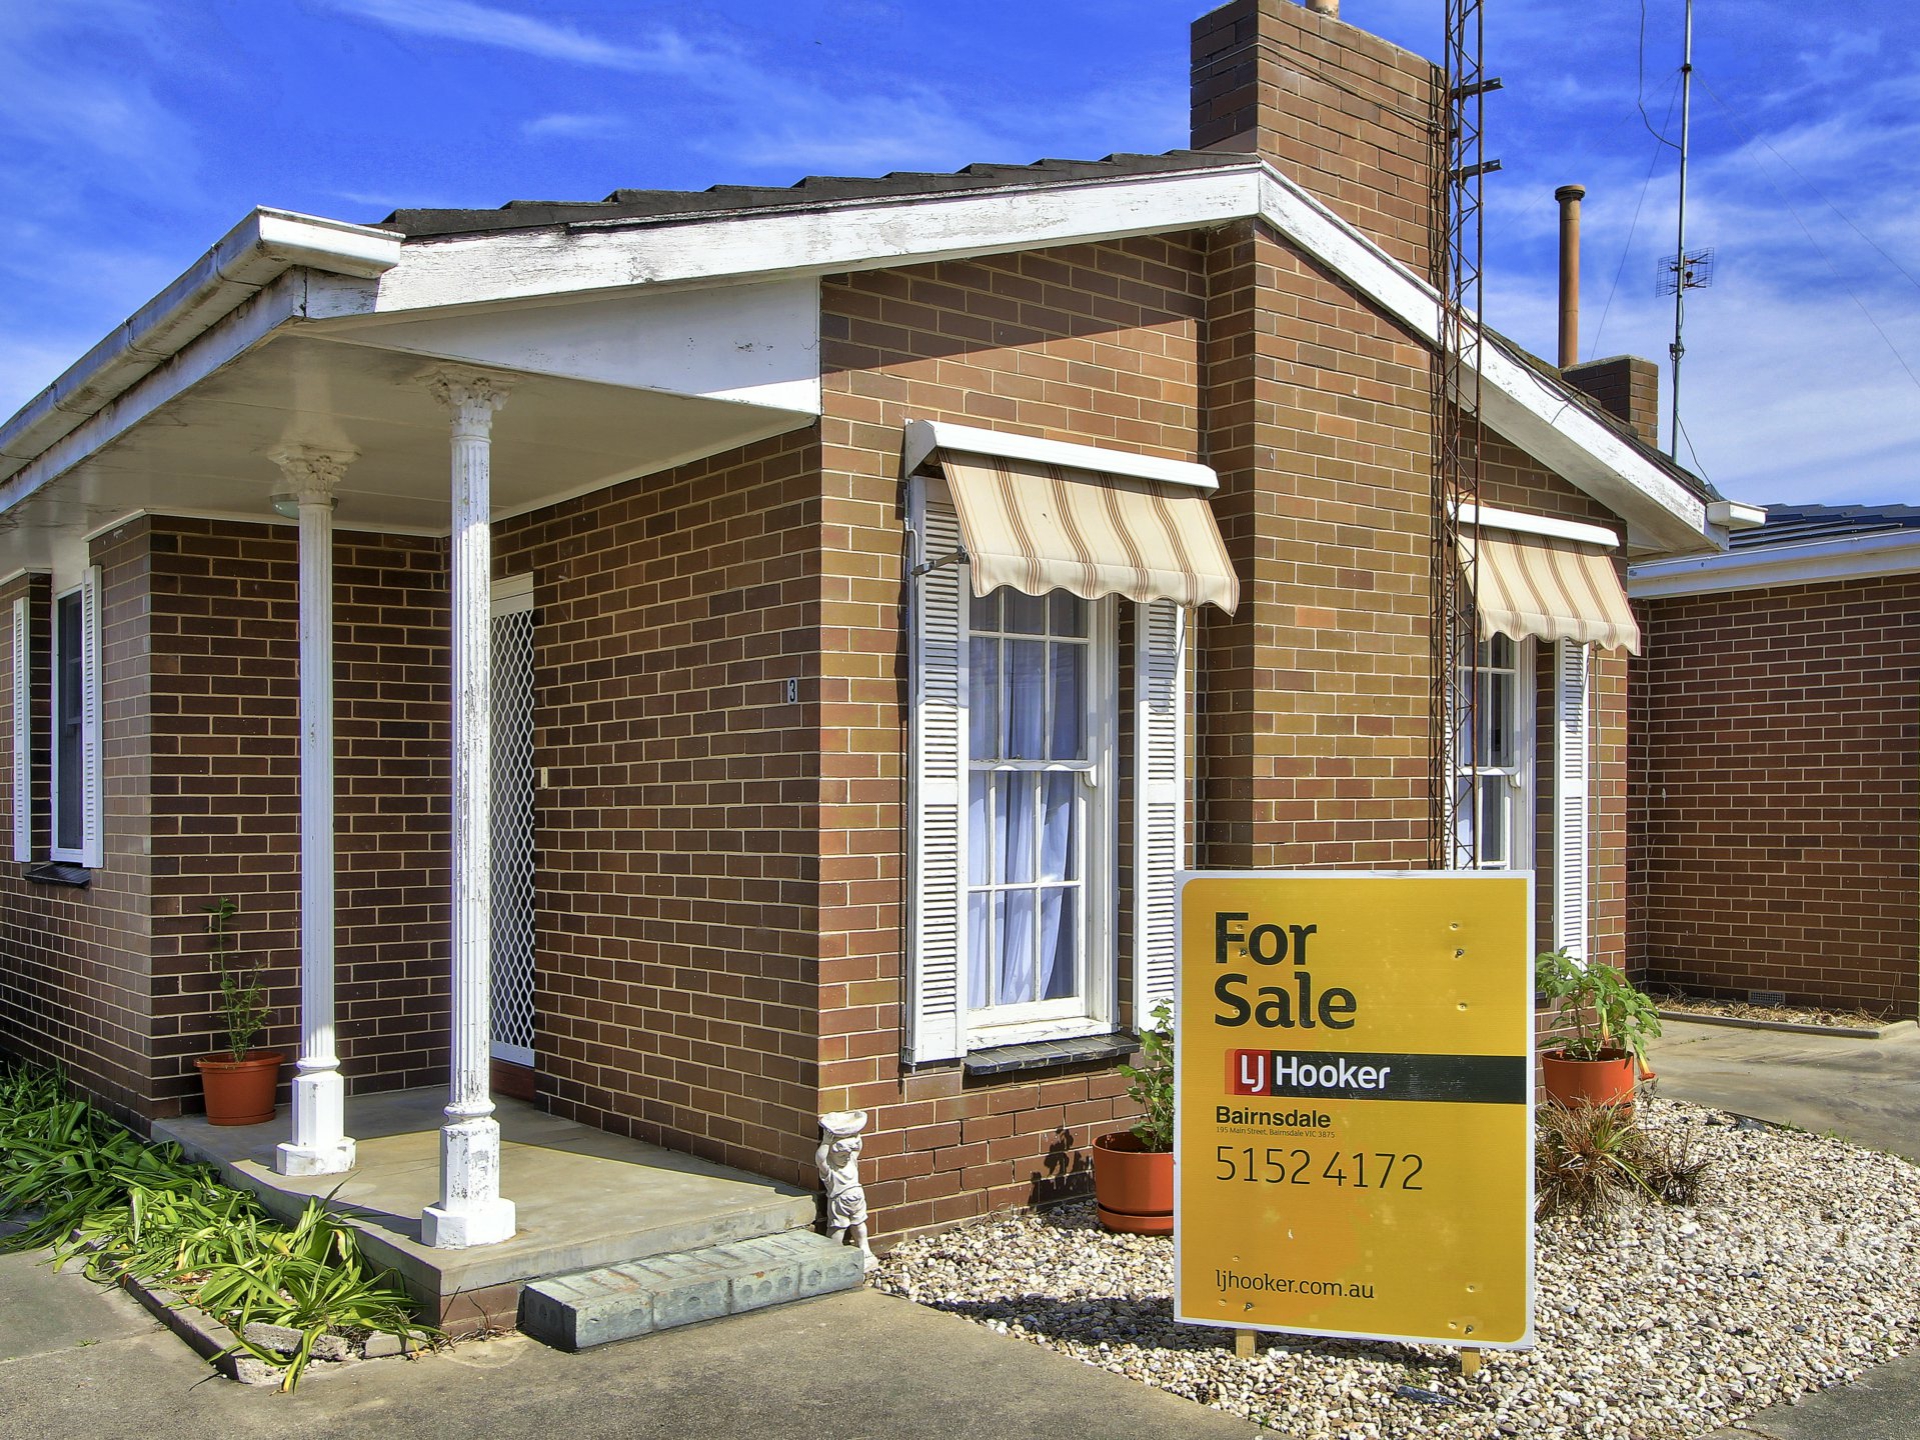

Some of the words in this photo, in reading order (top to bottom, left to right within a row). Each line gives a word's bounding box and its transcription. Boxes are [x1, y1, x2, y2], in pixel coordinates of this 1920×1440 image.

[789, 679, 796, 702] 3
[1215, 911, 1317, 965] For
[1214, 971, 1357, 1029] Sale
[1241, 1055, 1265, 1092] LJ
[1276, 1056, 1390, 1089] Hooker
[1216, 1106, 1330, 1128] Bairnsdale
[1269, 1129, 1304, 1137] Bairnsdale
[1216, 1146, 1311, 1184] 5152
[1322, 1151, 1424, 1191] 4172
[1215, 1270, 1375, 1299] ljhooker.com.au
